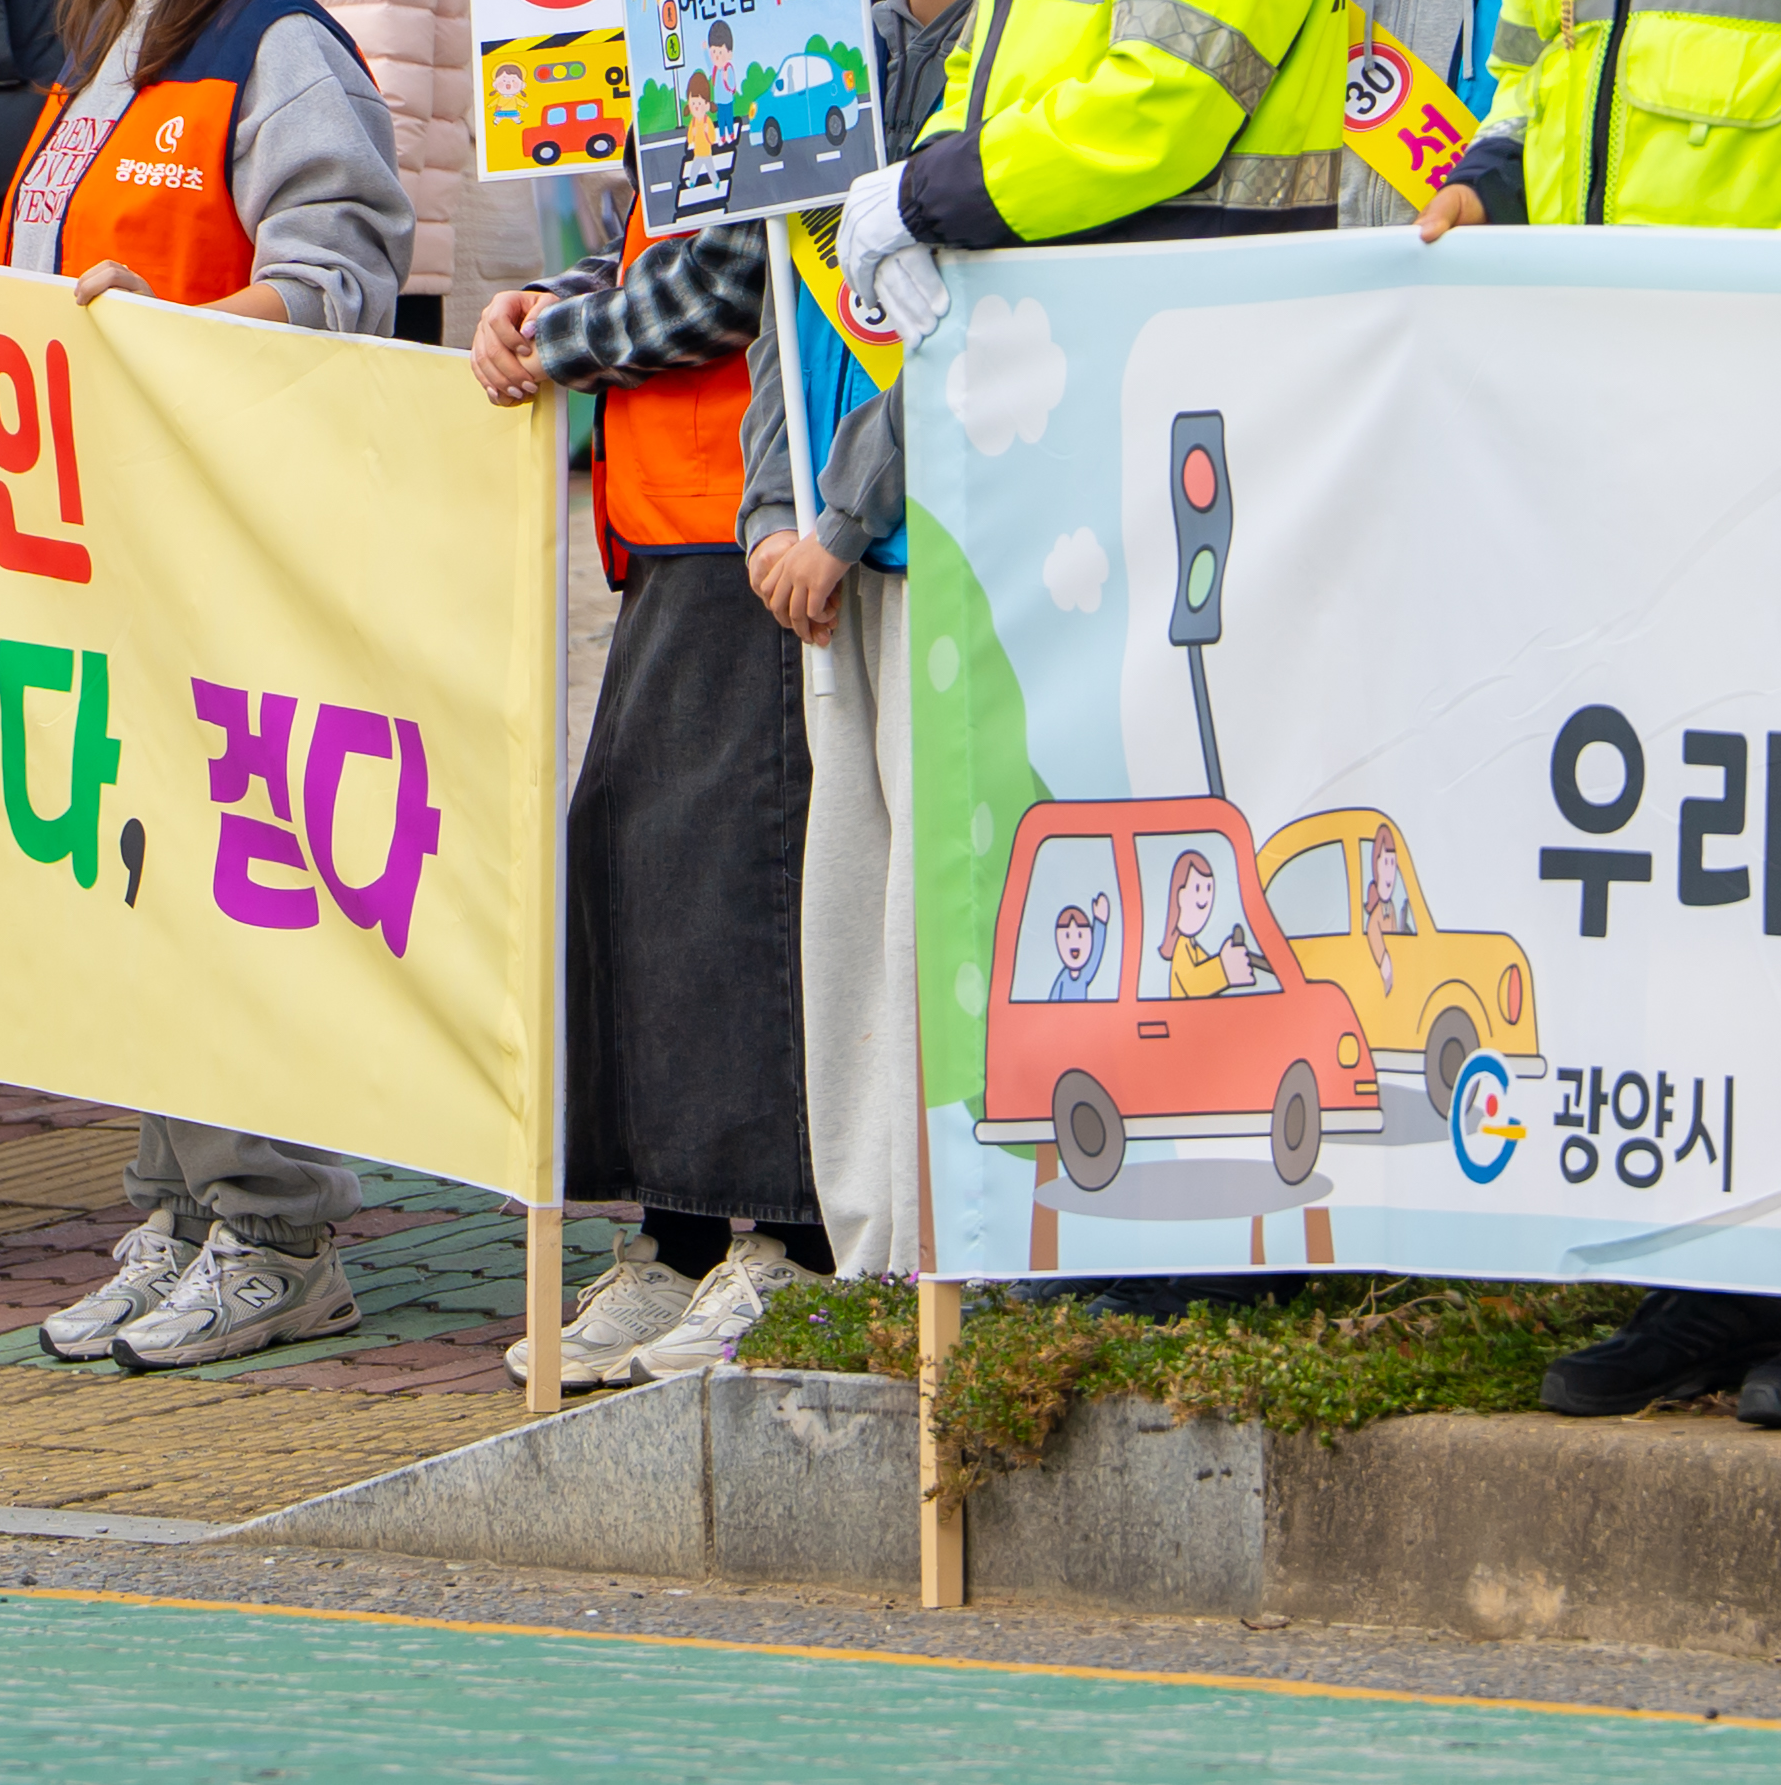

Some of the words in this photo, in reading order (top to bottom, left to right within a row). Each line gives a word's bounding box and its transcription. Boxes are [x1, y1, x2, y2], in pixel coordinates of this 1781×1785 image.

[1345, 61, 1396, 115] 30
[115, 157, 204, 191] 광양중앙초
[190, 676, 442, 960] 걷다
[1553, 1065, 1736, 1193] 광양시
